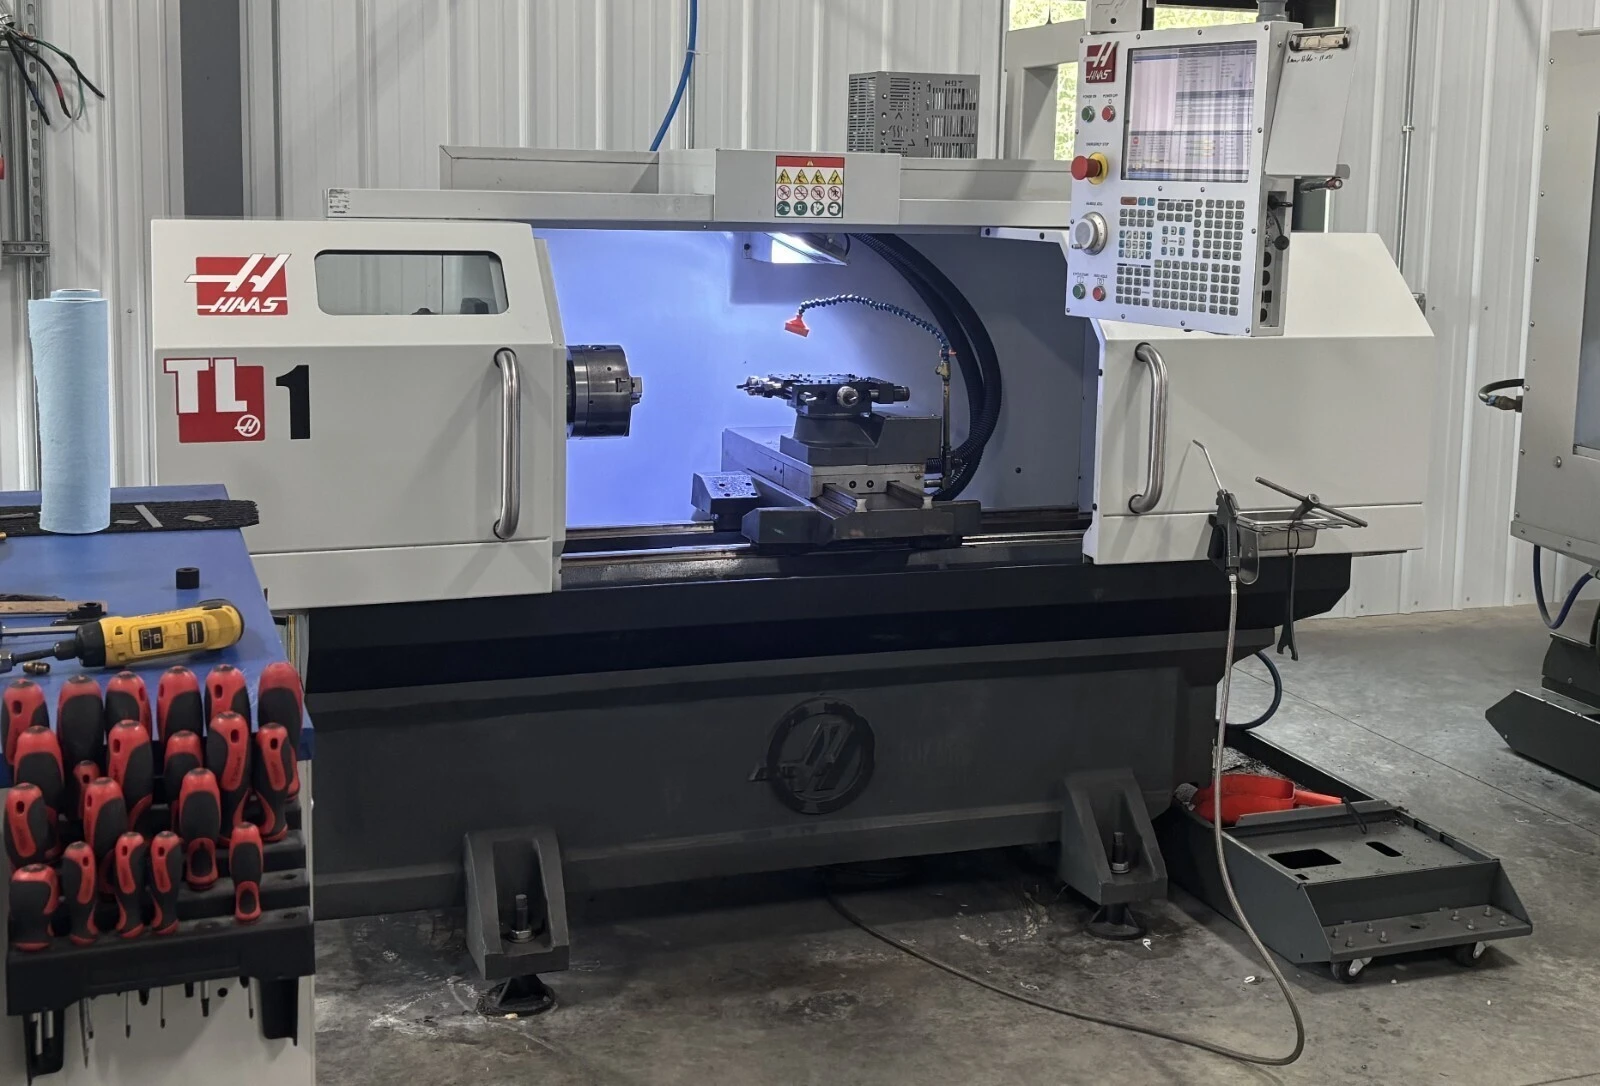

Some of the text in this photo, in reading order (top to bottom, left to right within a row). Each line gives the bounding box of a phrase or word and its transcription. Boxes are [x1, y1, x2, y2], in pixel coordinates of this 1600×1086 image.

[1086, 70, 1112, 81] HAAS
[198, 296, 287, 312] HAAS
[276, 365, 310, 440] 1
